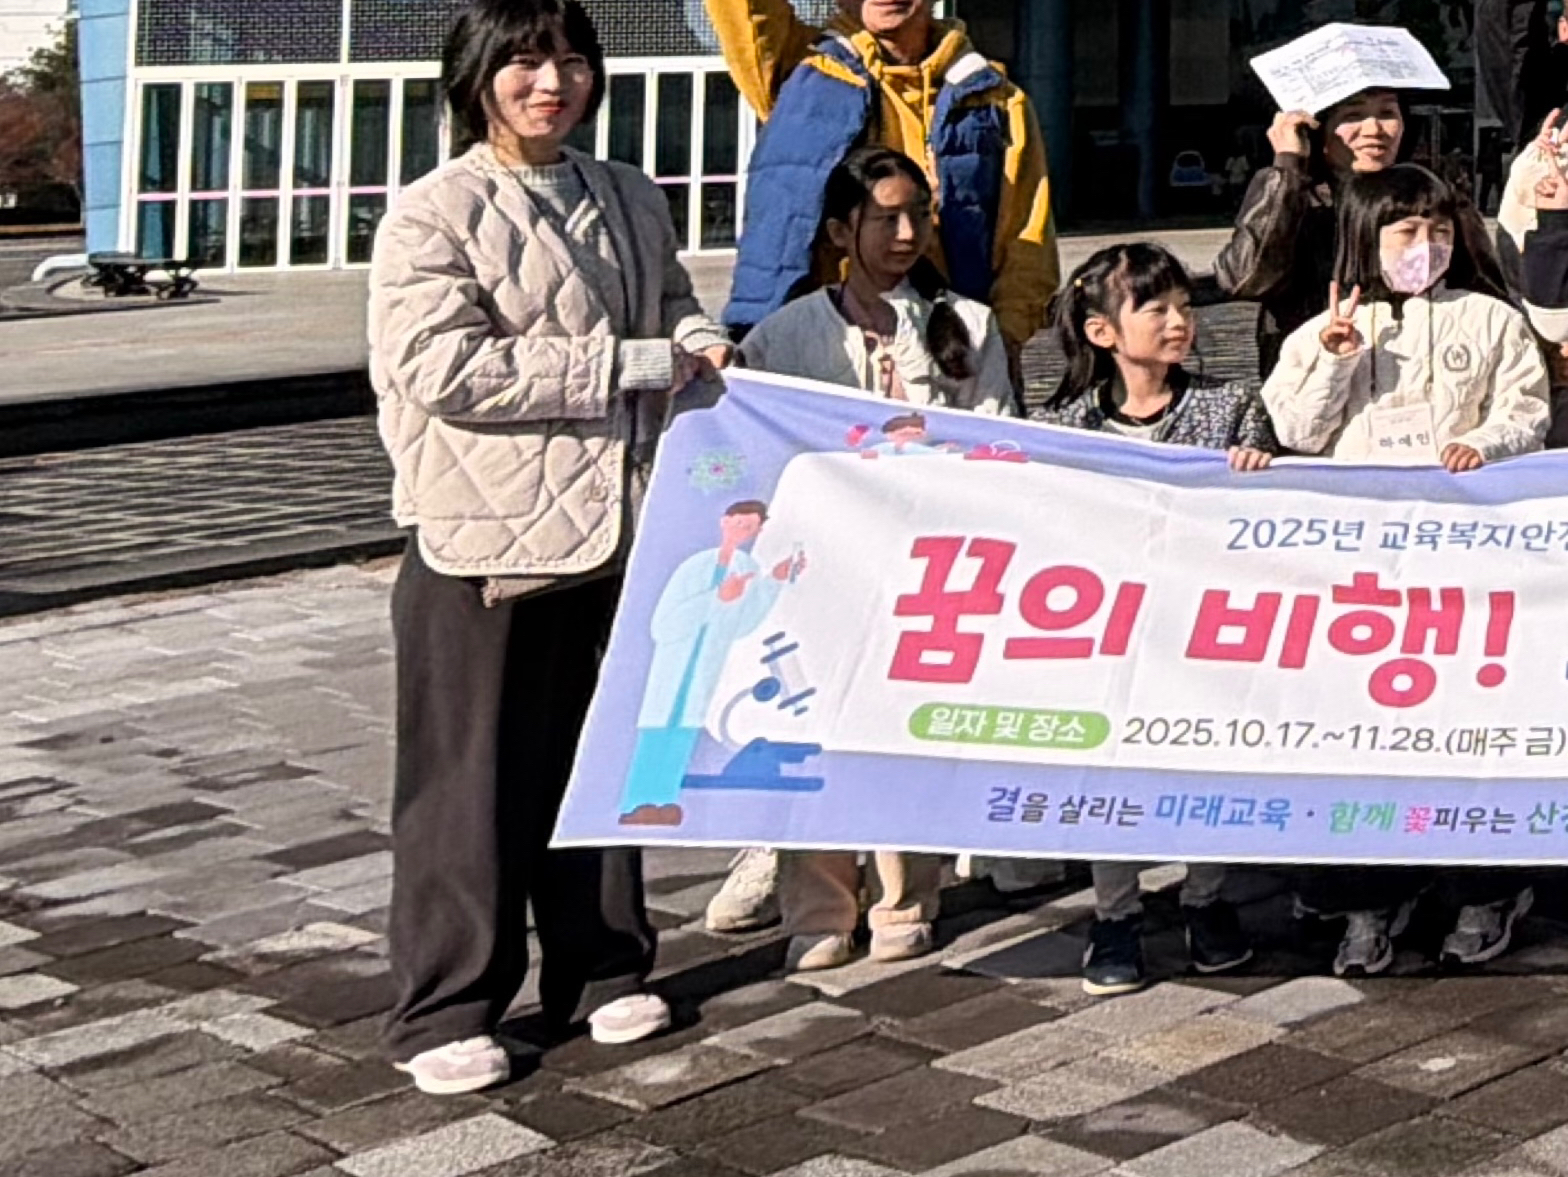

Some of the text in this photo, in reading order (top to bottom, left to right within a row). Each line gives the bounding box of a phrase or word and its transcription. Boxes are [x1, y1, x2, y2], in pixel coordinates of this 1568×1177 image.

[1227, 517, 1364, 552] 2025년
[887, 535, 1147, 684] 꿈의
[1184, 571, 1515, 708] 비행!
[926, 706, 1088, 744] 일자 및 장소
[987, 787, 1050, 825] 결을
[1058, 794, 1145, 828] 살리는
[1155, 794, 1292, 833] 미래교육
[1329, 800, 1397, 834] 함께
